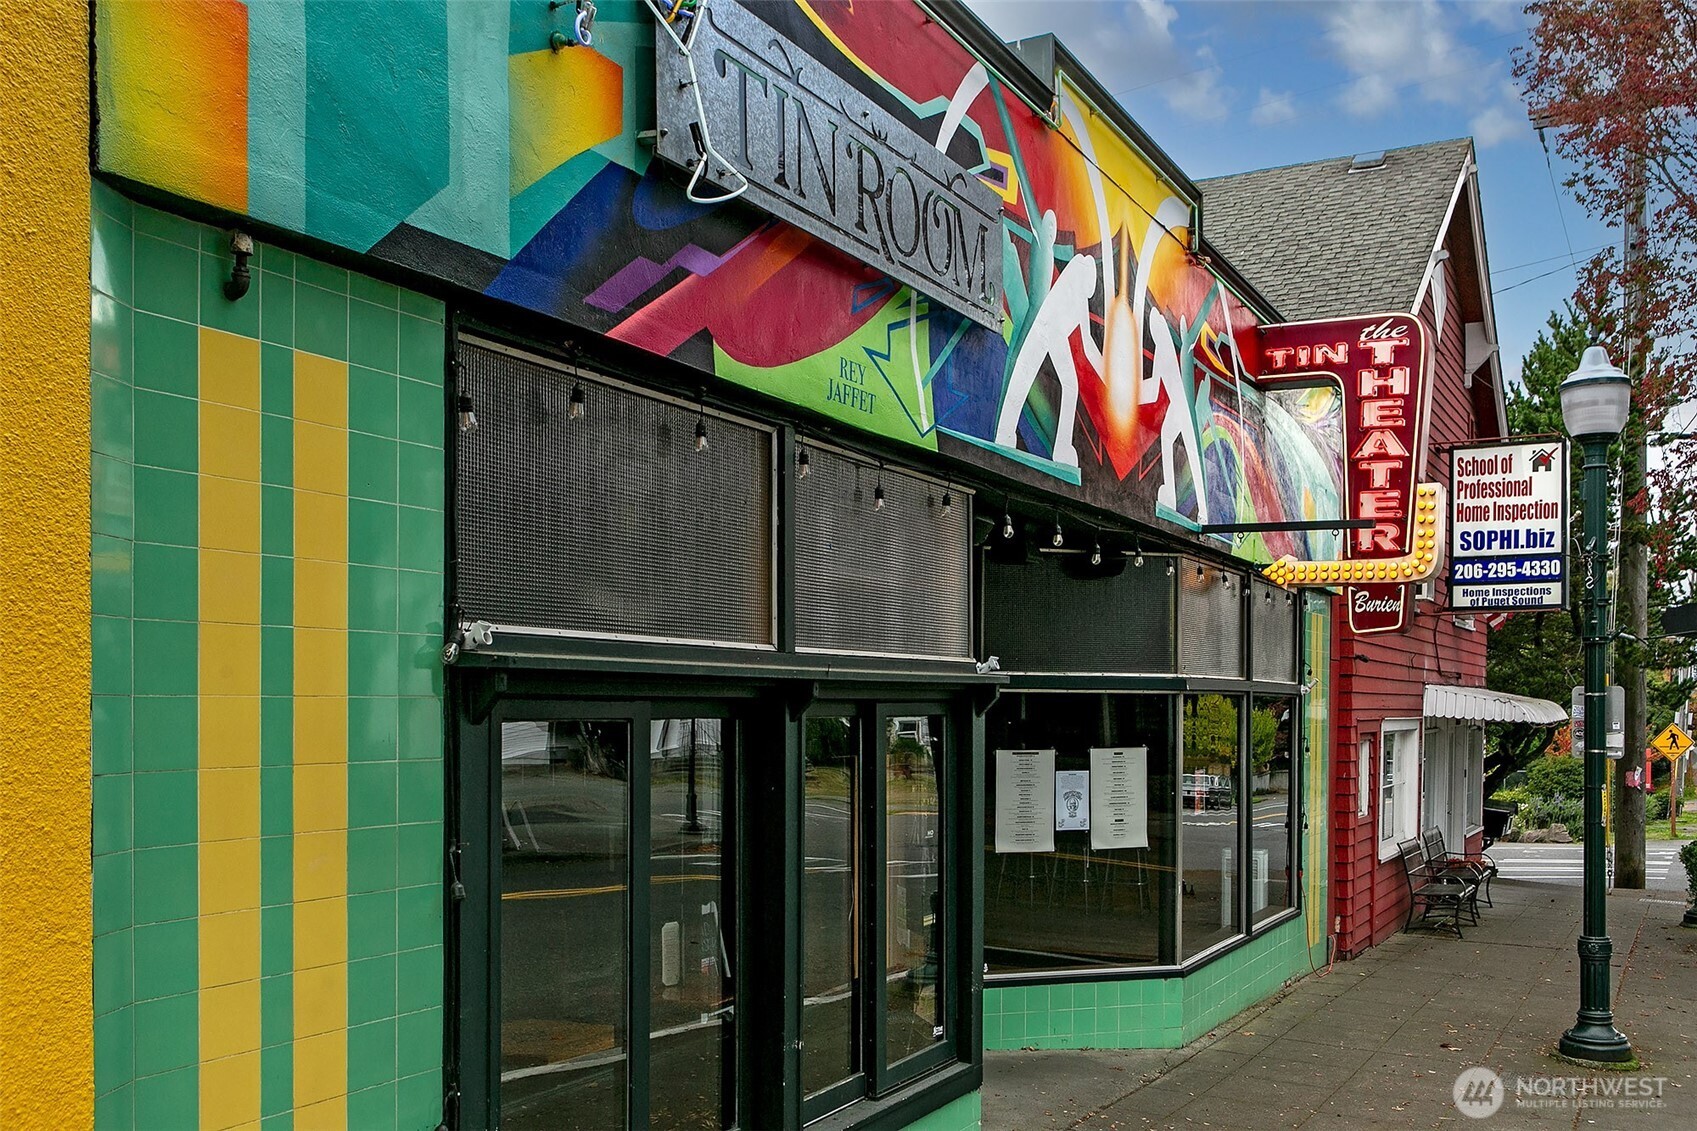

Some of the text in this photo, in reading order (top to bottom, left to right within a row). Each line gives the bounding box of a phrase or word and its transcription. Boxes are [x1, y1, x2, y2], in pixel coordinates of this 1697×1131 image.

[714, 48, 838, 217] TIN
[1359, 318, 1409, 341] the
[1265, 341, 1349, 369] TIN
[840, 356, 866, 386] REY
[827, 378, 876, 415] JAFFET
[1351, 338, 1410, 551] THEATER
[1457, 453, 1513, 478] School of
[1456, 475, 1533, 500] Professional
[1456, 499, 1559, 523] Home Inspection
[1459, 528, 1555, 552] SOPHI.biz
[1454, 559, 1561, 580] 206-295-4330
[1354, 591, 1401, 613] Burien
[1462, 586, 1552, 598] Home Inspections
[1470, 595, 1543, 607] of Puget Sound
